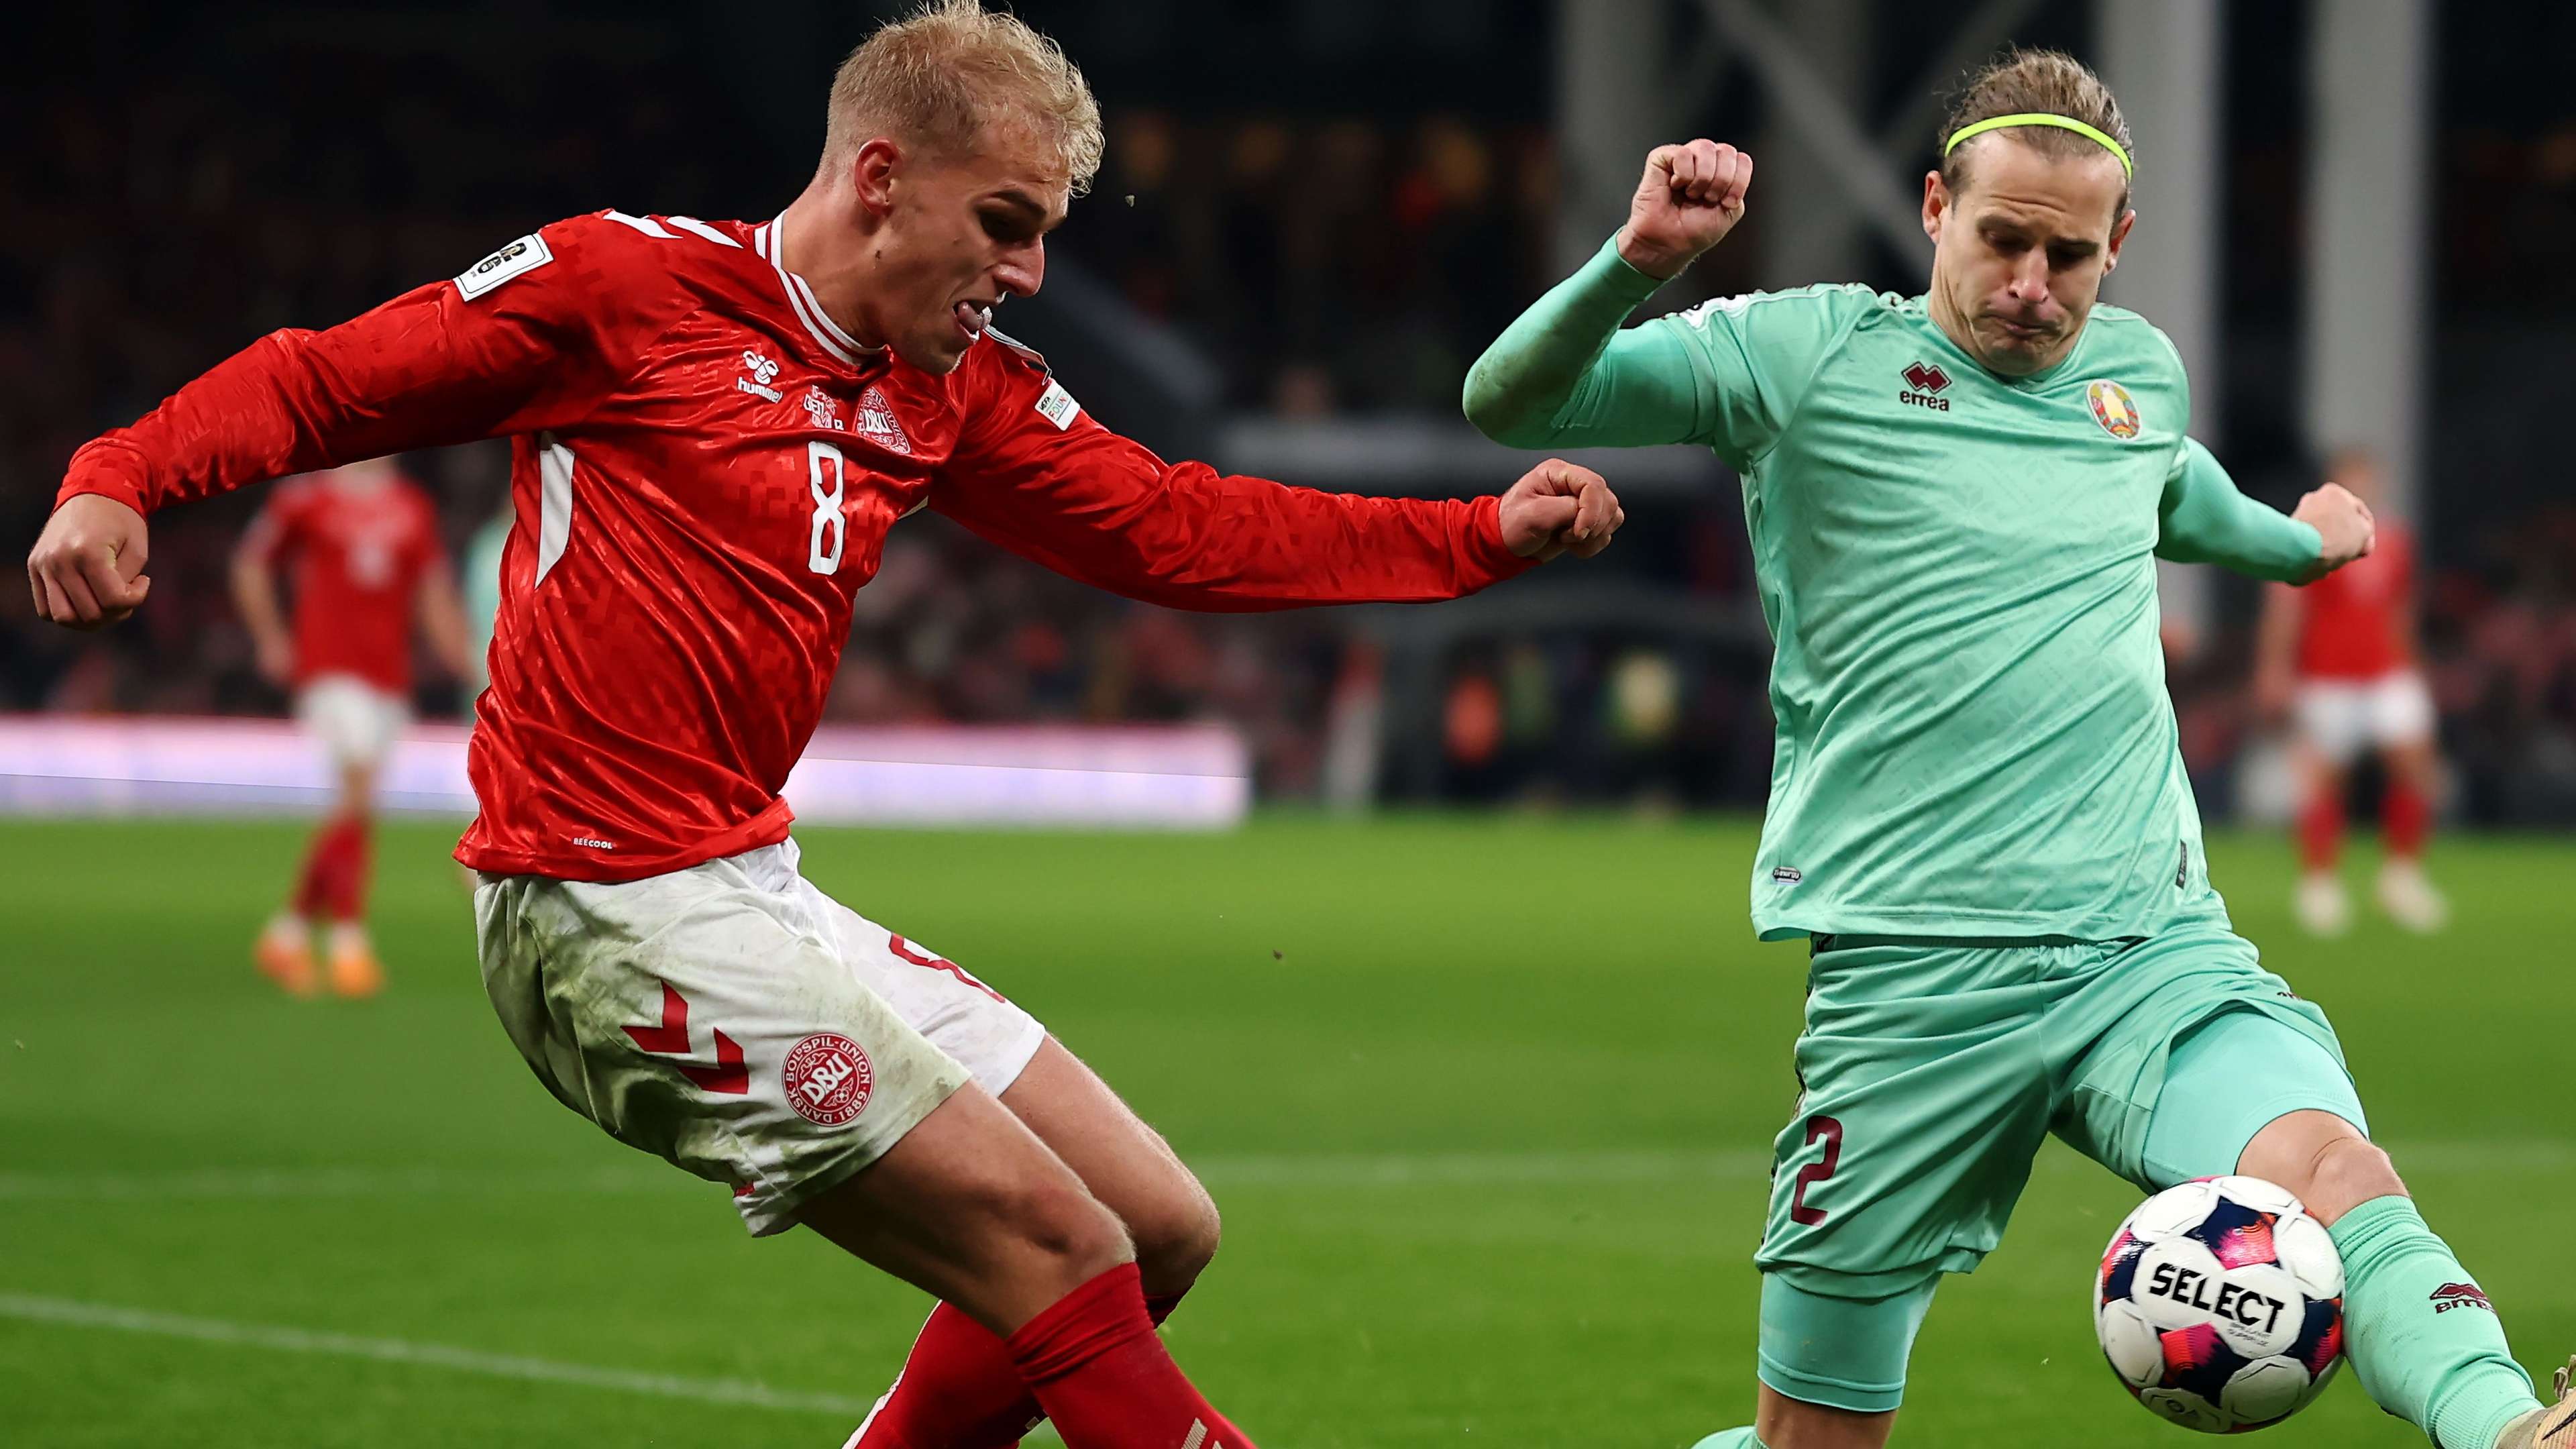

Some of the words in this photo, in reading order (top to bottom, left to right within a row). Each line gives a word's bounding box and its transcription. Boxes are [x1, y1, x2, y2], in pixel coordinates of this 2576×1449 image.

[737, 376, 784, 402] hummel
[1899, 390, 1950, 412] errea
[807, 441, 846, 576] 8
[573, 837, 613, 850] BEECOOL
[800, 1052, 854, 1106] DBU
[788, 1087, 833, 1124] DANSK
[837, 1091, 867, 1121] 1889
[1790, 1115, 1843, 1227] 2
[2149, 1262, 2285, 1334] SELECT
